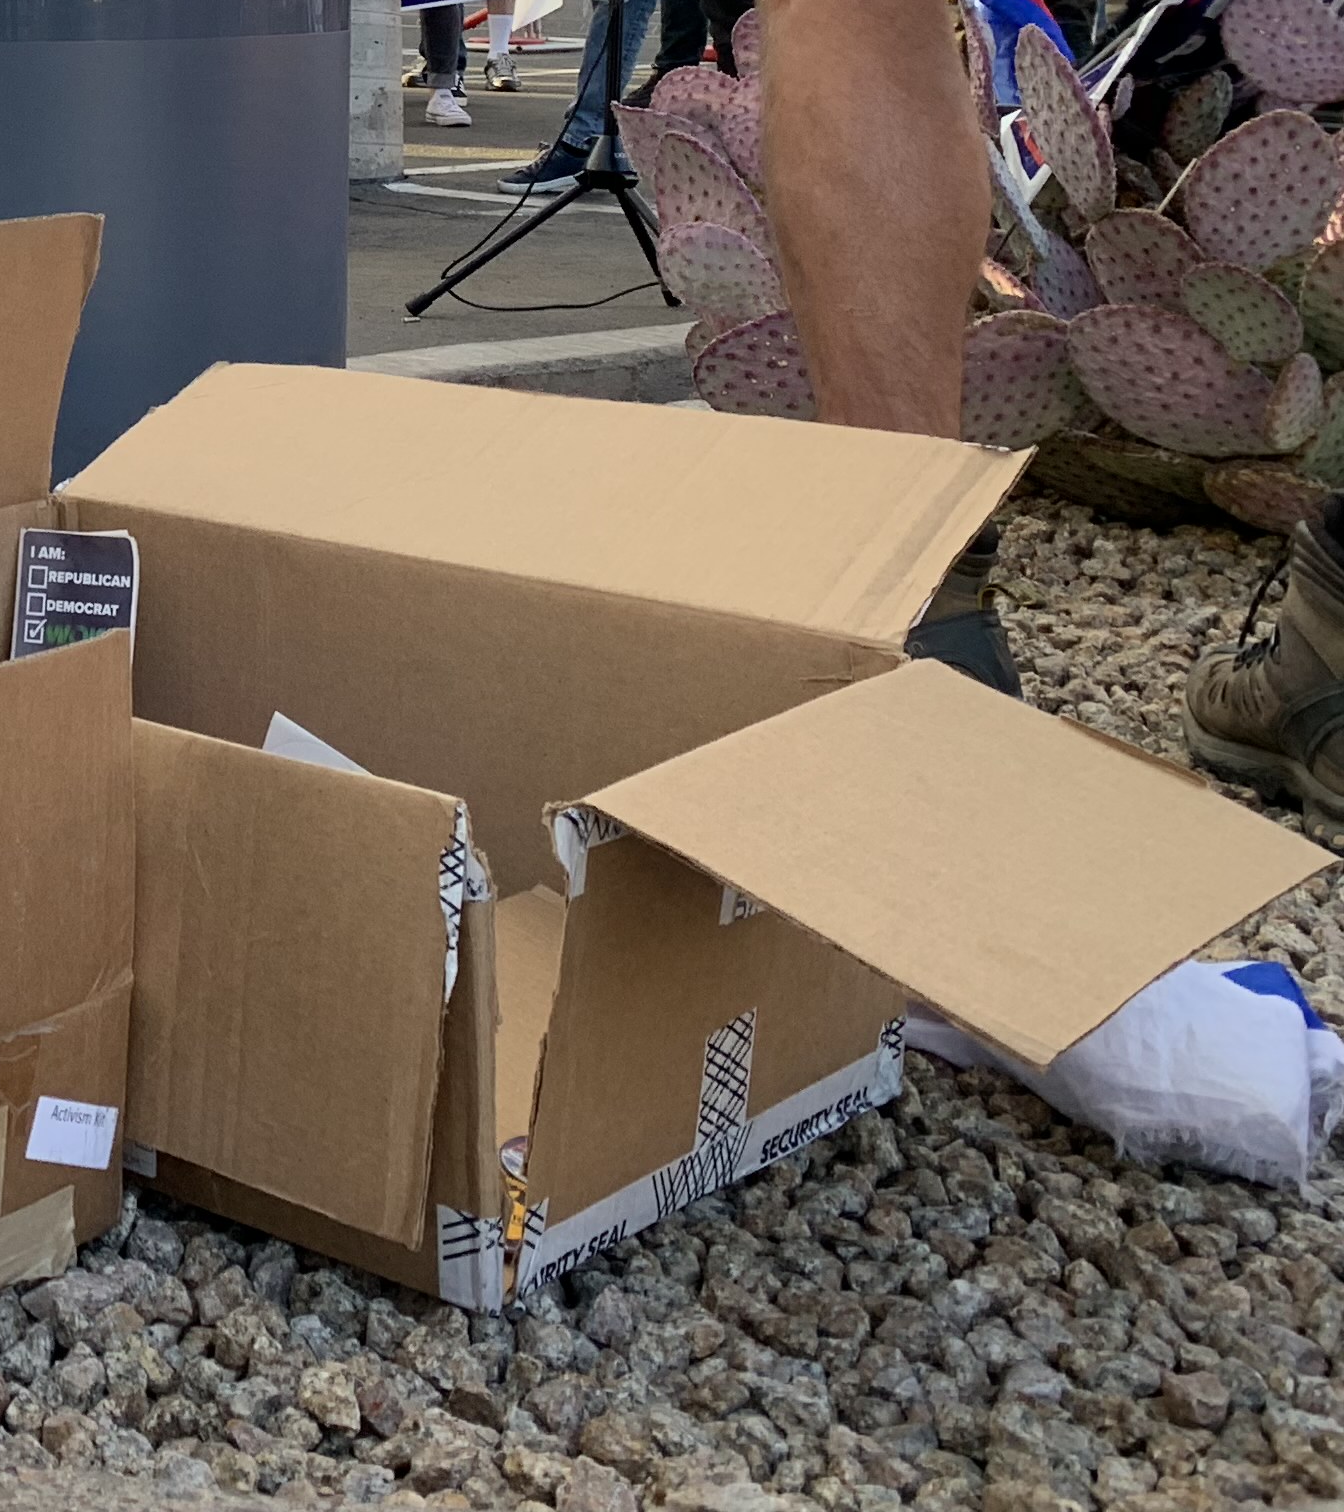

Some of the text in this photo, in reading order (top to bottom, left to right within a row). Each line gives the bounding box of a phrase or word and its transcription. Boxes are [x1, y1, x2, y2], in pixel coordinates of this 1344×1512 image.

[30, 546, 65, 560] I AM:
[48, 571, 131, 587] REPUBLICAN
[47, 600, 119, 616] DEMOCRAT
[52, 1105, 92, 1125] Activism
[759, 1086, 874, 1164] SECURITY SEAL
[583, 1219, 627, 1258] SEAL
